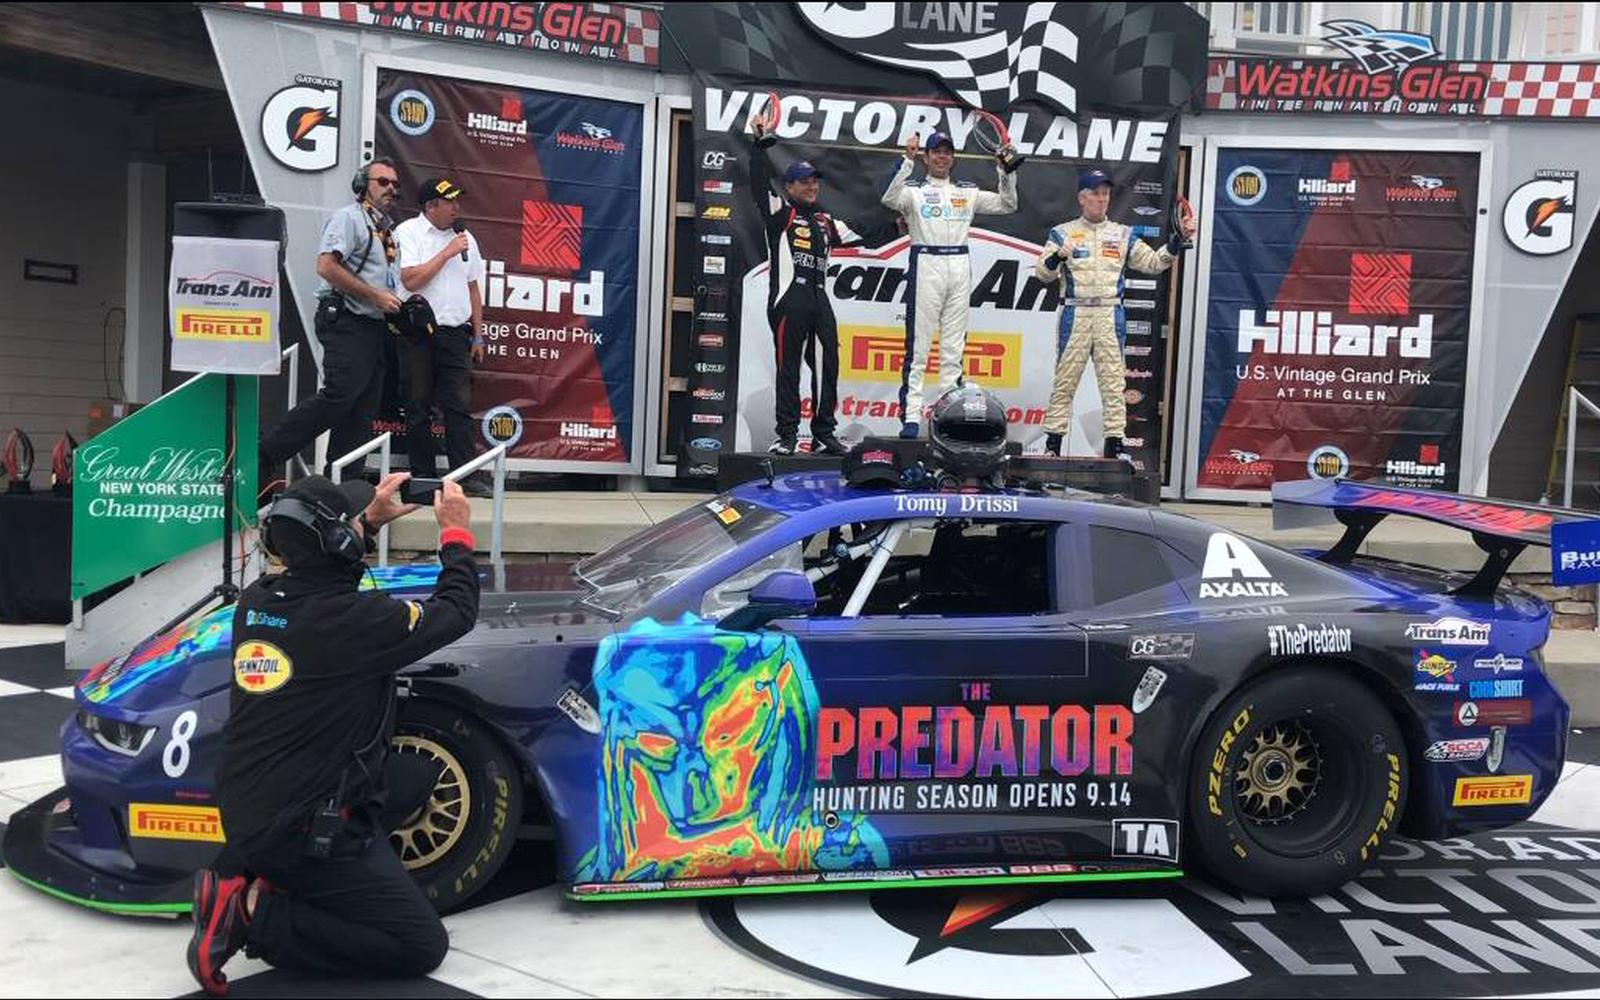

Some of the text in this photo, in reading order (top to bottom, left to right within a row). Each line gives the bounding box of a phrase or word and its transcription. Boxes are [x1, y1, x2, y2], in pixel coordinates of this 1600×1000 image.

[371, 2, 622, 43] atkins Glen
[902, 2, 999, 34] LANE
[295, 74, 339, 87] GATORADE
[1239, 63, 1484, 99] Watkins Glen
[1240, 100, 1477, 114] INTERNATIONAL
[467, 112, 527, 135] Hilliard
[706, 88, 1168, 163] VICTORY LANE
[1298, 178, 1356, 194] Hilliard
[175, 277, 274, 299] Trans Am
[826, 262, 907, 304] ran
[181, 313, 263, 336] PIRELLI
[515, 322, 567, 343] Grand
[572, 327, 603, 345] Prix
[1238, 309, 1434, 358] Hilliard
[487, 344, 560, 360] HE GLEN
[851, 335, 1006, 377] PIRELI
[1236, 364, 1431, 386] U.S. Vintage Grand Prix
[1277, 387, 1387, 401] AT THE GLEN
[560, 422, 617, 440] Hilliard
[79, 445, 244, 483] Great Weste
[1386, 459, 1445, 476] Hilliard
[100, 482, 225, 496] NEW YORK STATE
[894, 495, 1018, 517] Tomy Drissi
[1561, 551, 1600, 561] Bu
[1199, 582, 1289, 598] AXALTA
[1267, 623, 1352, 656] #ThePredator
[1412, 625, 1487, 640] Trans Am
[238, 658, 279, 673] PENNZOIL
[960, 682, 991, 700] THE
[162, 710, 198, 778] 8
[814, 704, 1135, 780] PREDATOR
[813, 782, 1132, 811] HUNTING SEASON OPENS 9.14
[1461, 781, 1526, 800] PIRELLI
[137, 811, 219, 835] PIRELLI
[1121, 823, 1171, 856] TA
